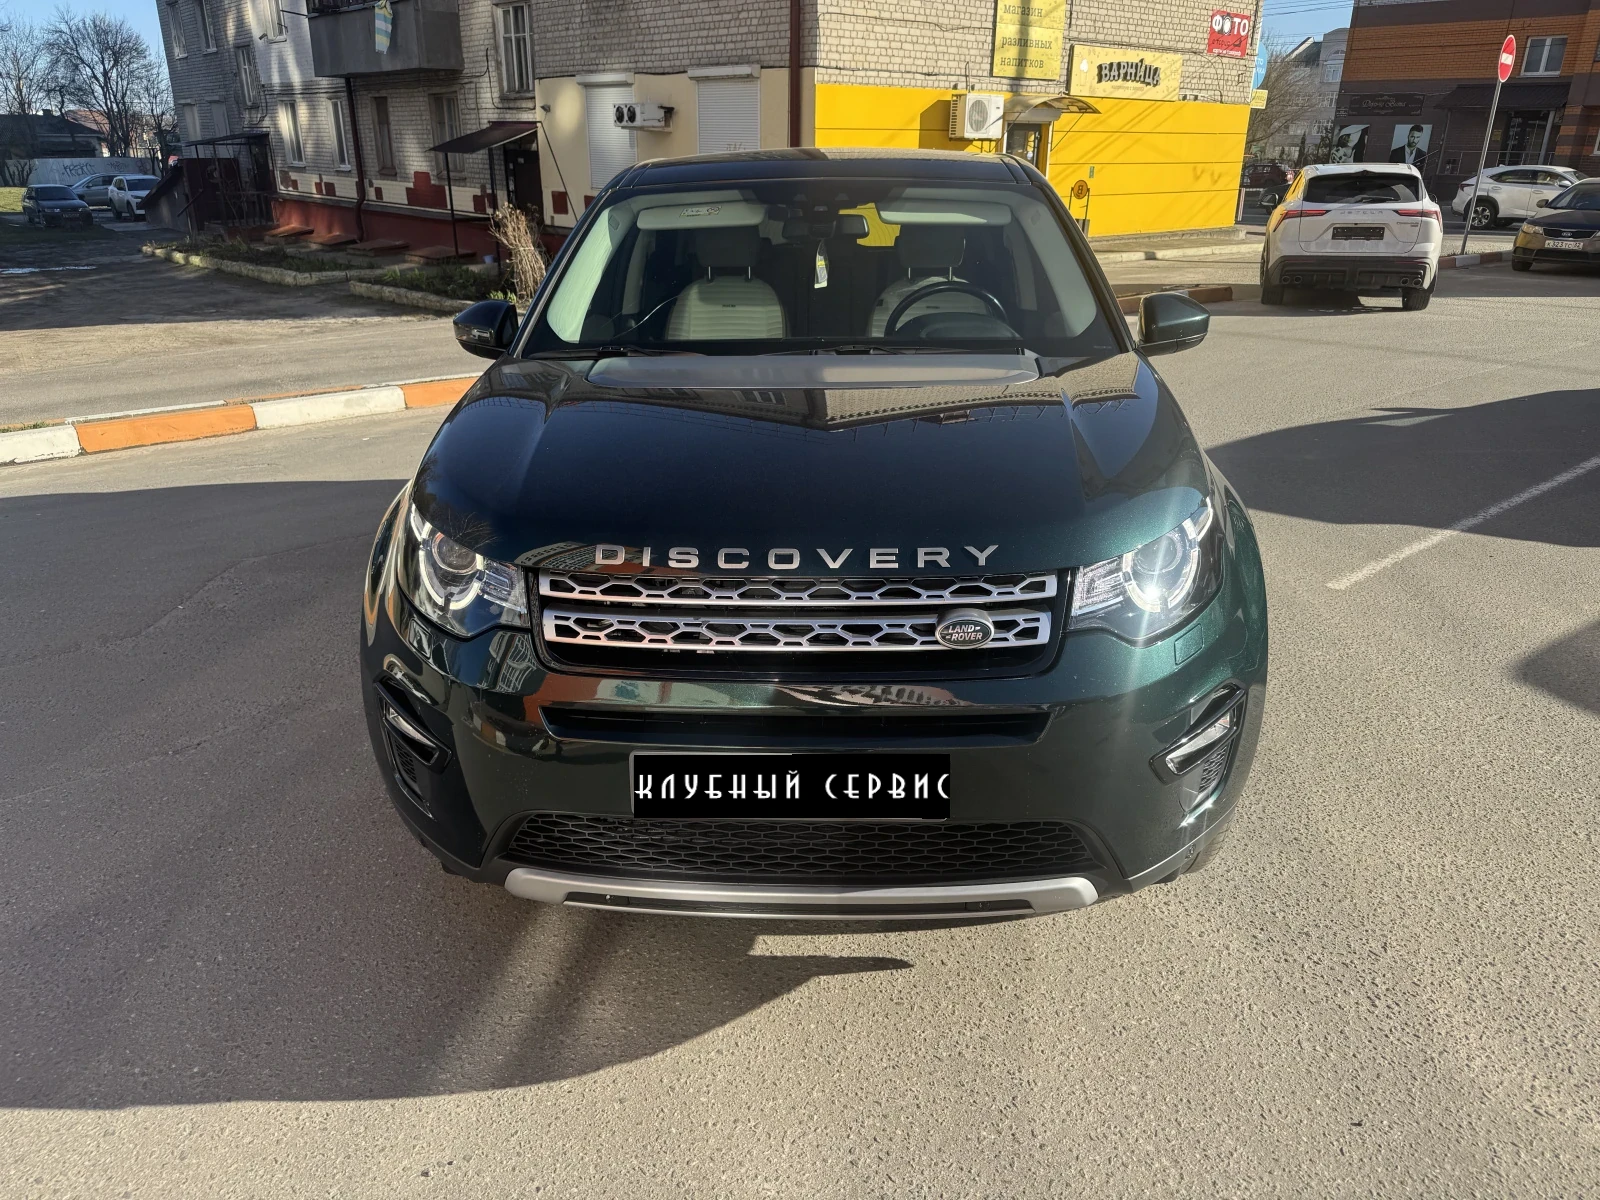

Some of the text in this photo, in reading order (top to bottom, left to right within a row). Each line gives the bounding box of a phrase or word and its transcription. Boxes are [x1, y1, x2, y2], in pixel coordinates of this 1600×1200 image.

[1003, 4, 1043, 18] магазин
[1001, 36, 1053, 50] разливных
[1000, 57, 1044, 69] напитков
[595, 544, 999, 569] DISCOVERY
